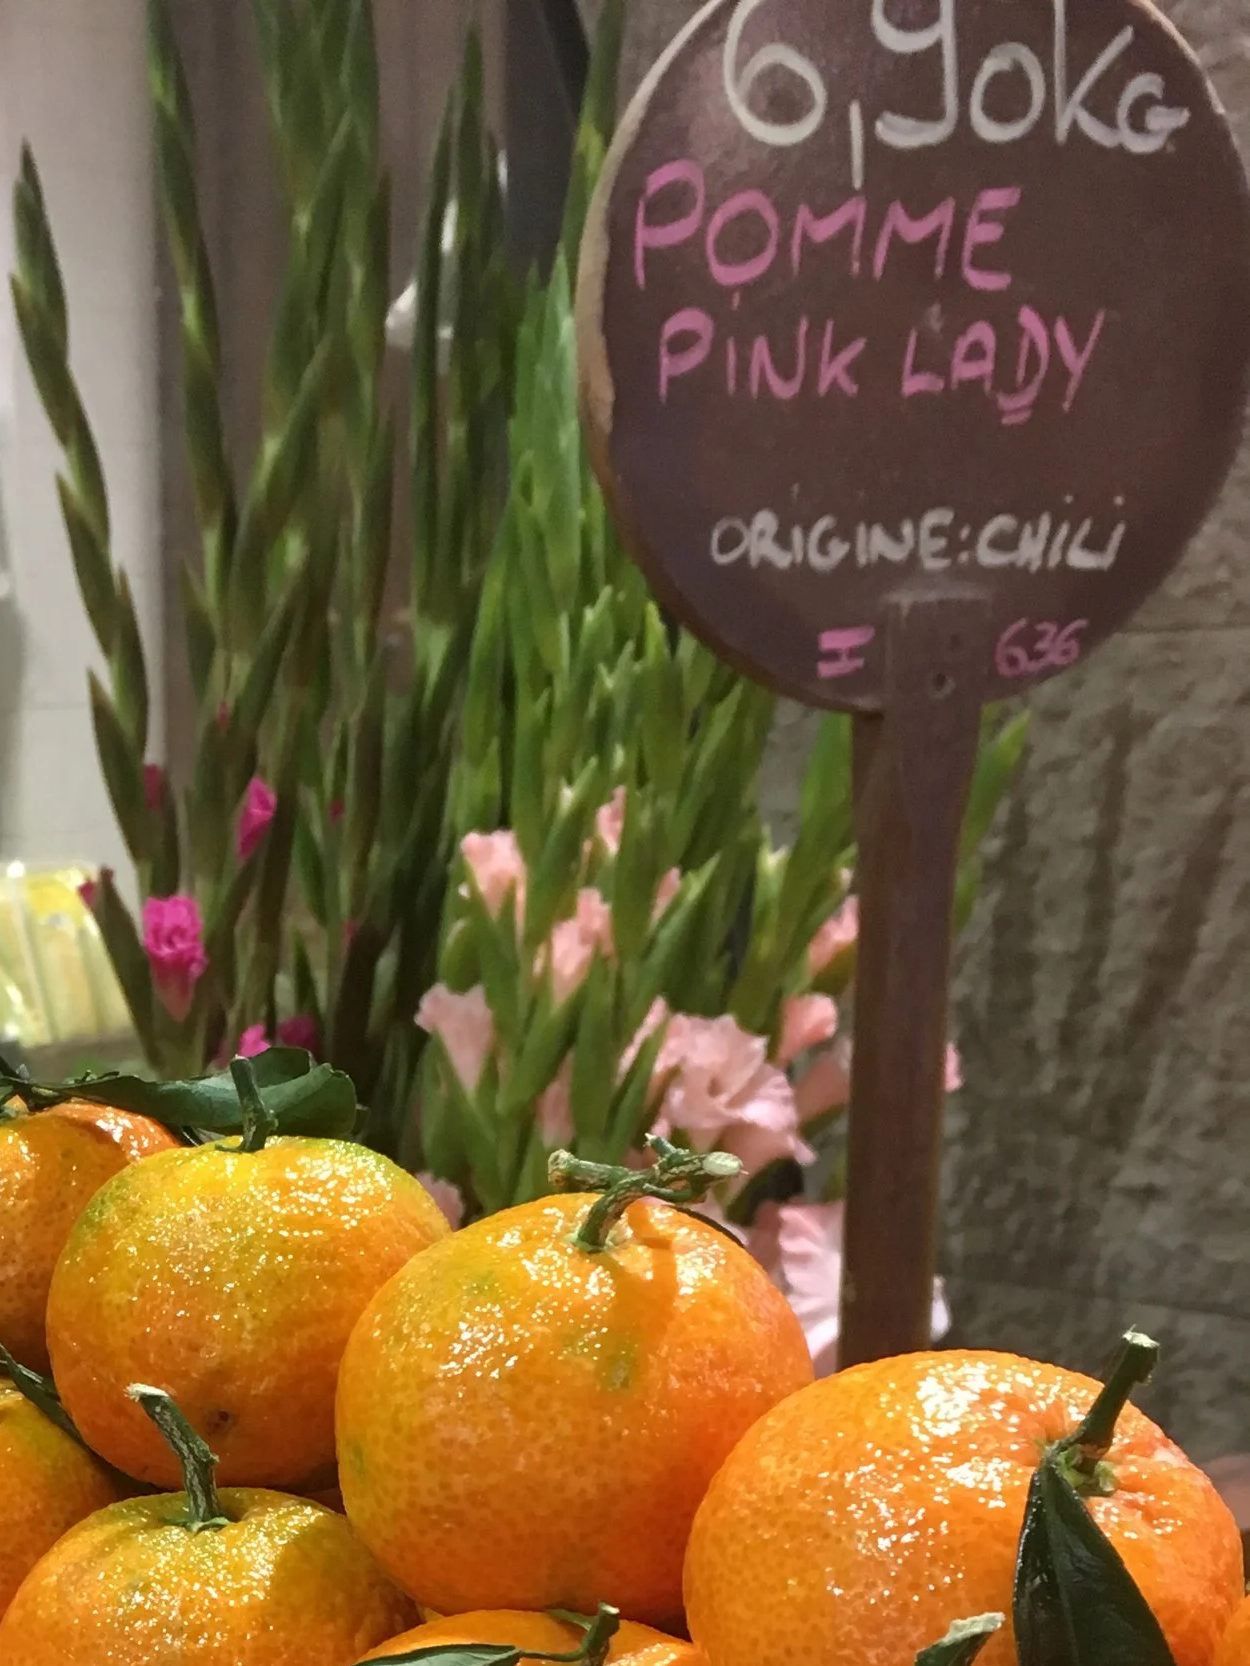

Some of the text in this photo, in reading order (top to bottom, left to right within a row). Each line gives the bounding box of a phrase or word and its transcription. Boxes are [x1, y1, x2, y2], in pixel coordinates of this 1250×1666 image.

[634, 158, 1022, 292] POMME
[900, 304, 1106, 426] LADY
[993, 616, 1090, 678] 636
